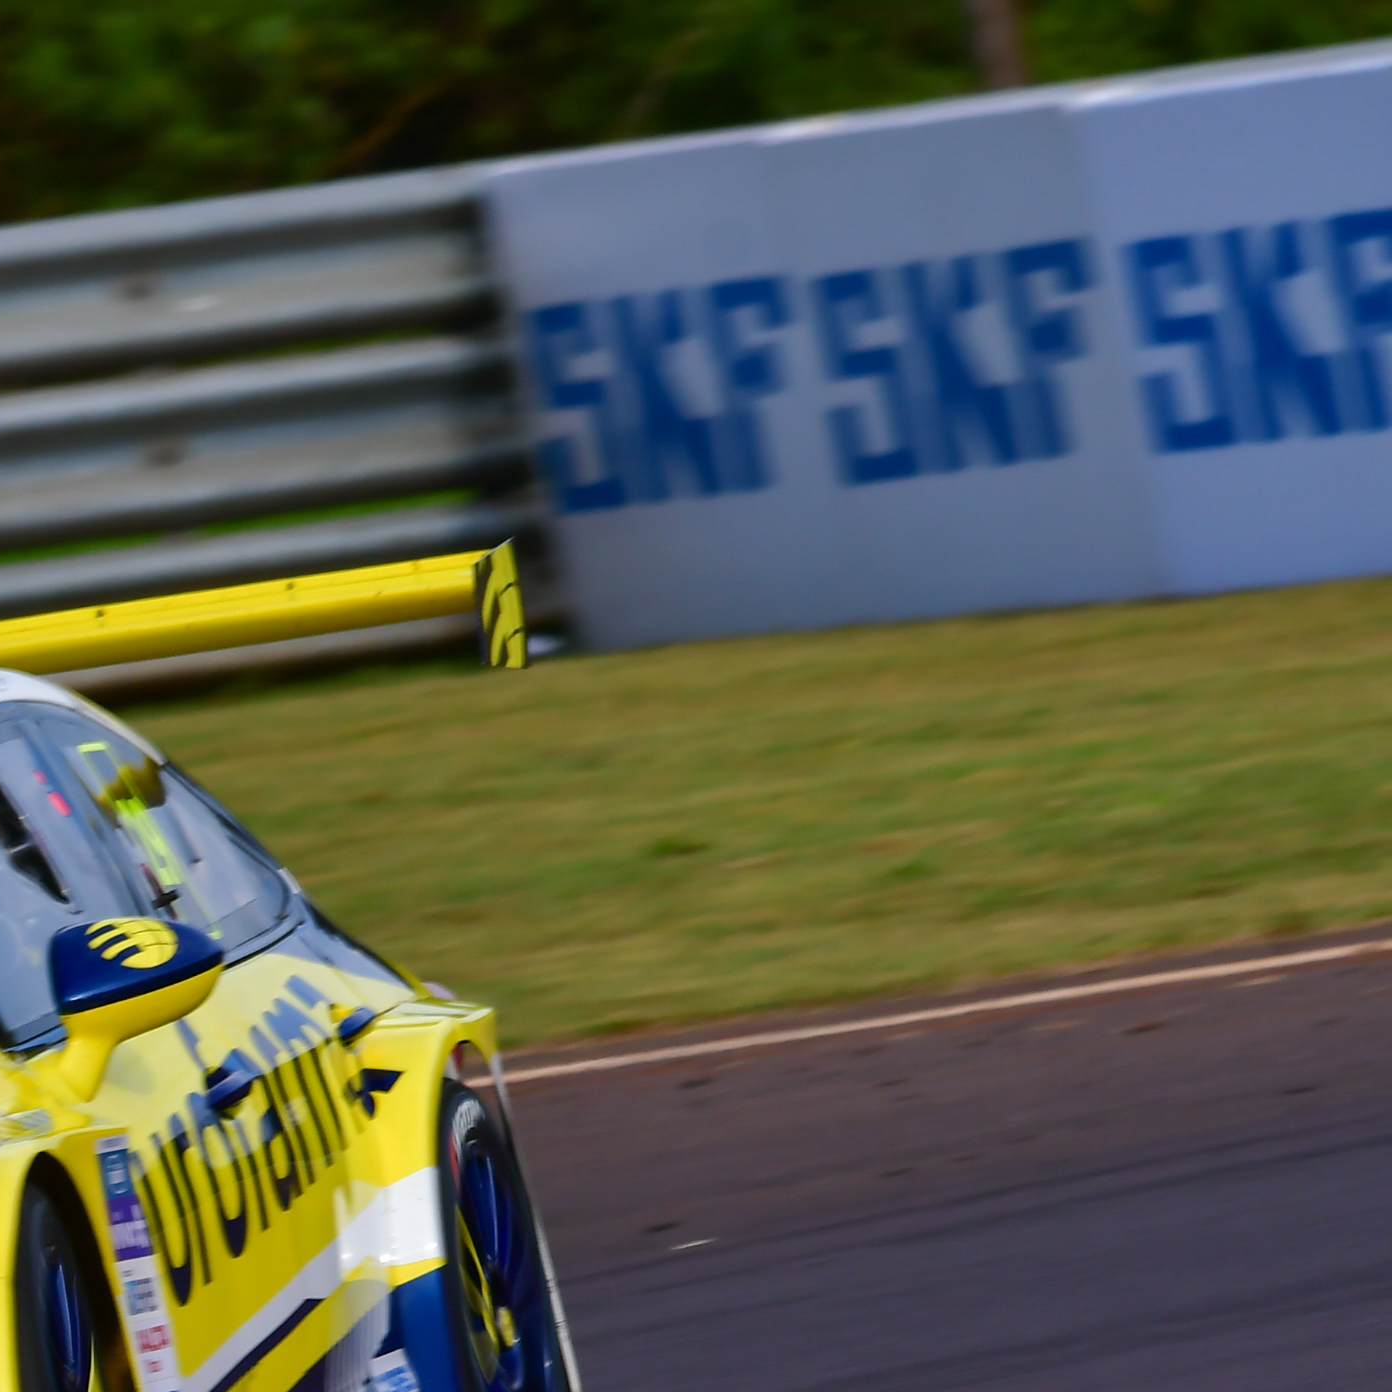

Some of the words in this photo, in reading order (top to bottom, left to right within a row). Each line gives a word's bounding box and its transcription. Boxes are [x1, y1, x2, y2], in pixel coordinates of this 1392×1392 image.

[524, 275, 790, 516] SKF
[812, 235, 1094, 489] SKF
[1120, 207, 1392, 456] SKF
